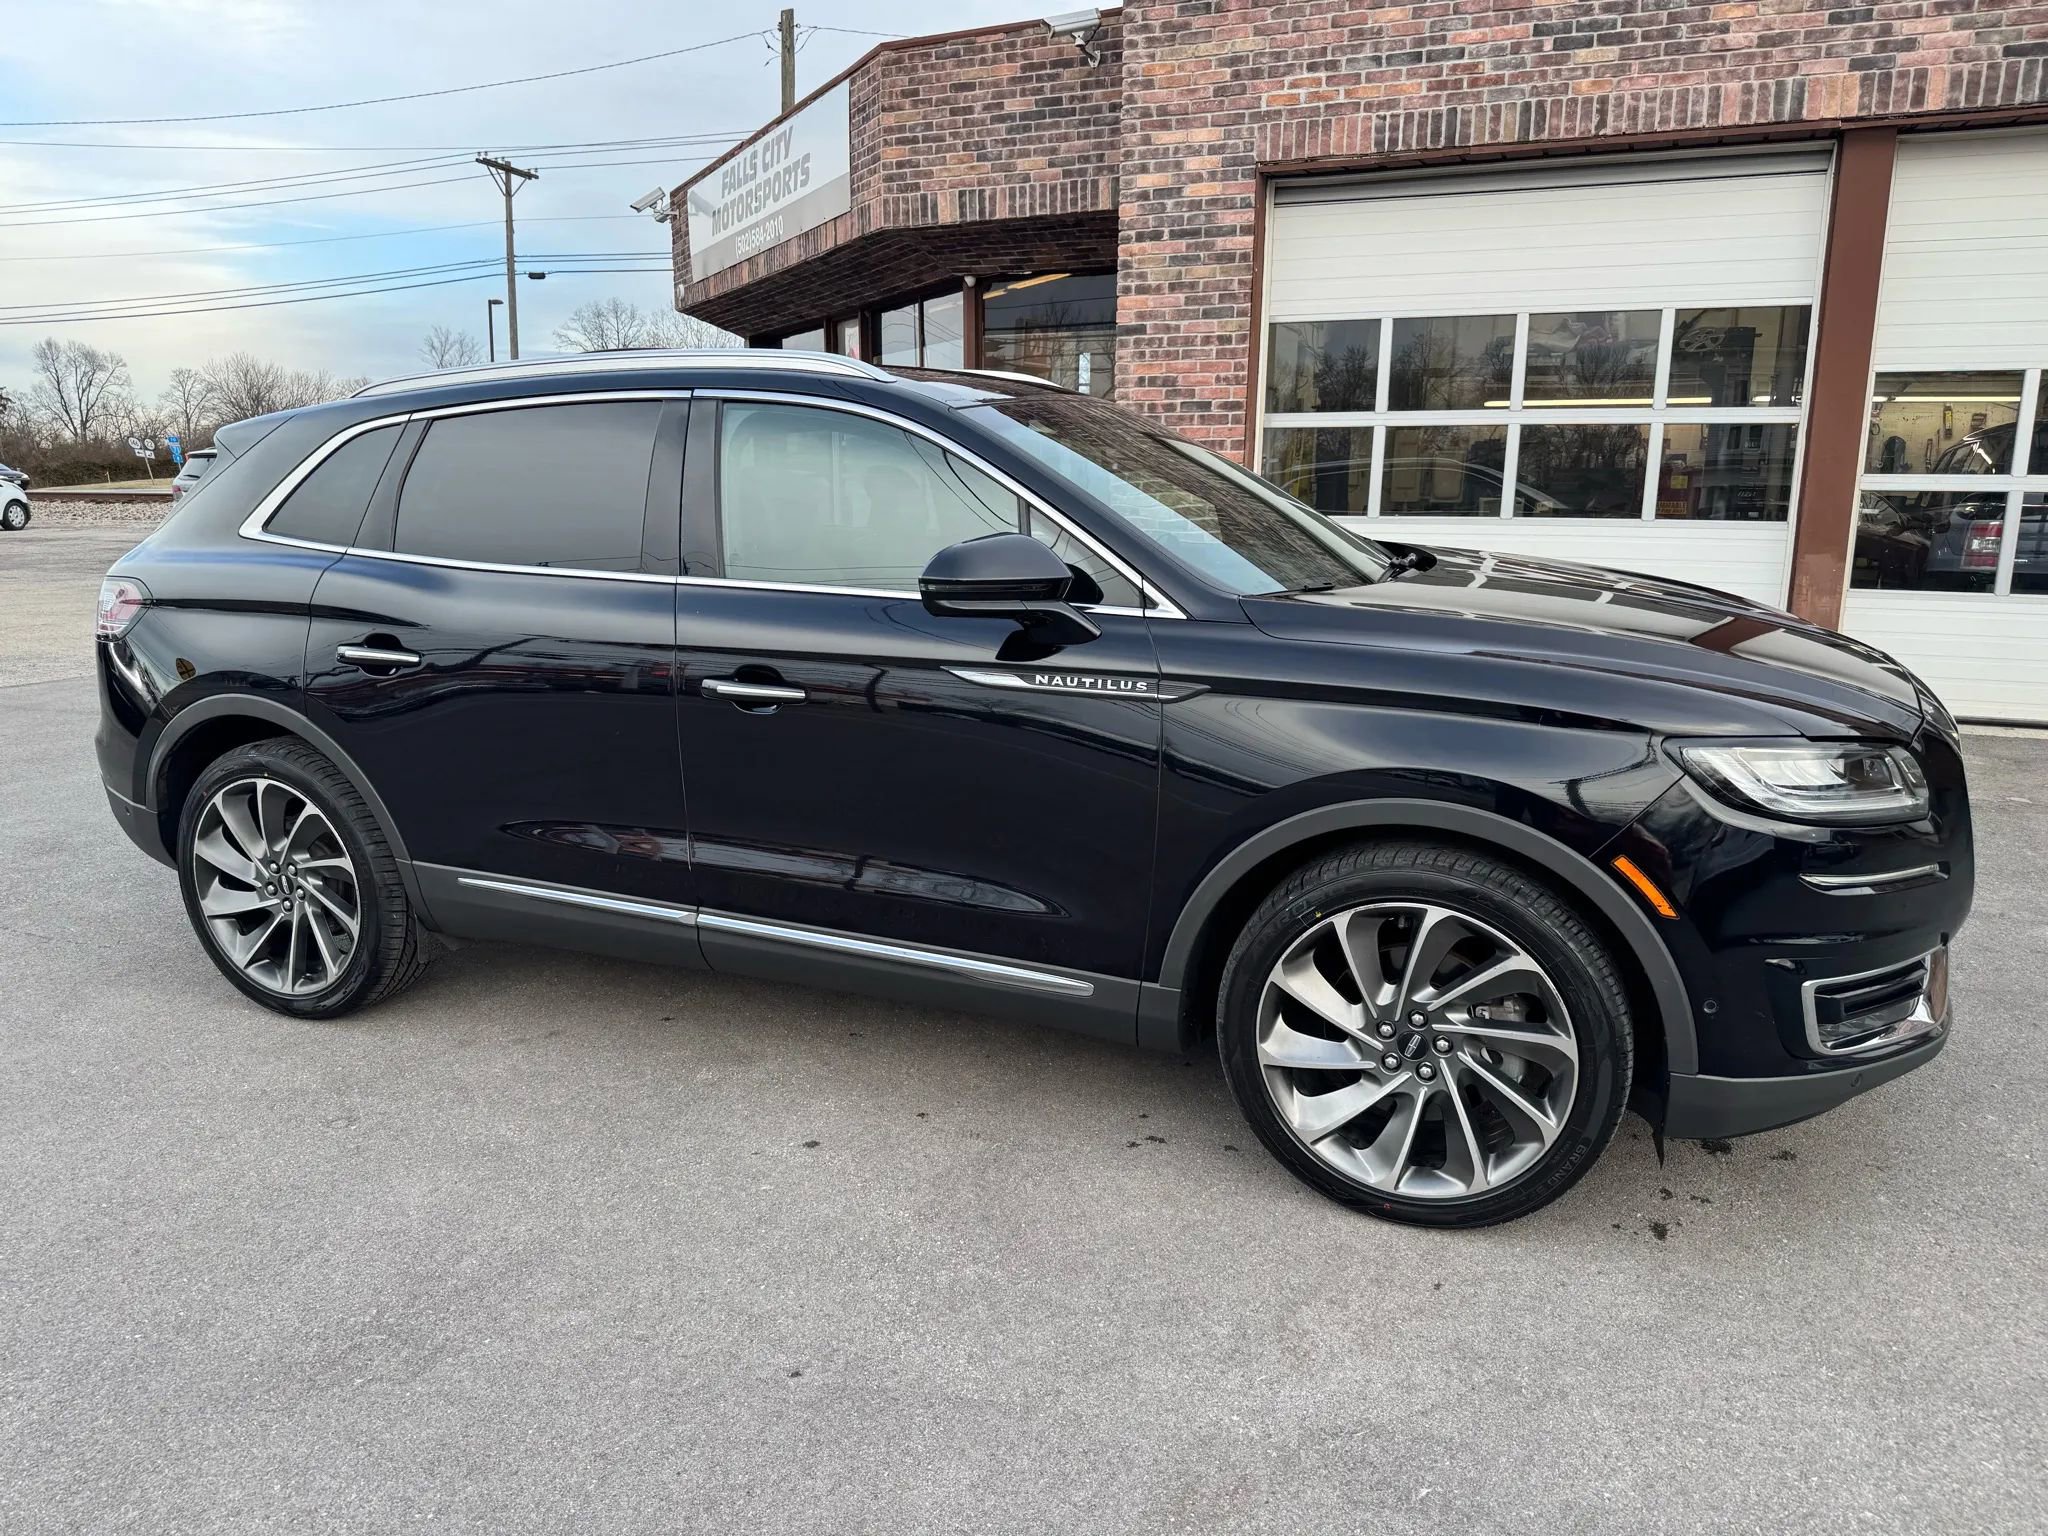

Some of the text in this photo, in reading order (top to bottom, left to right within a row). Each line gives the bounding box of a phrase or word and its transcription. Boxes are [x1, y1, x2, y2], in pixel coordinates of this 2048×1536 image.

[712, 152, 811, 237] MOTORSPORTS
[721, 125, 794, 199] FALLS CITY
[1035, 674, 1148, 691] NAUTILUS
